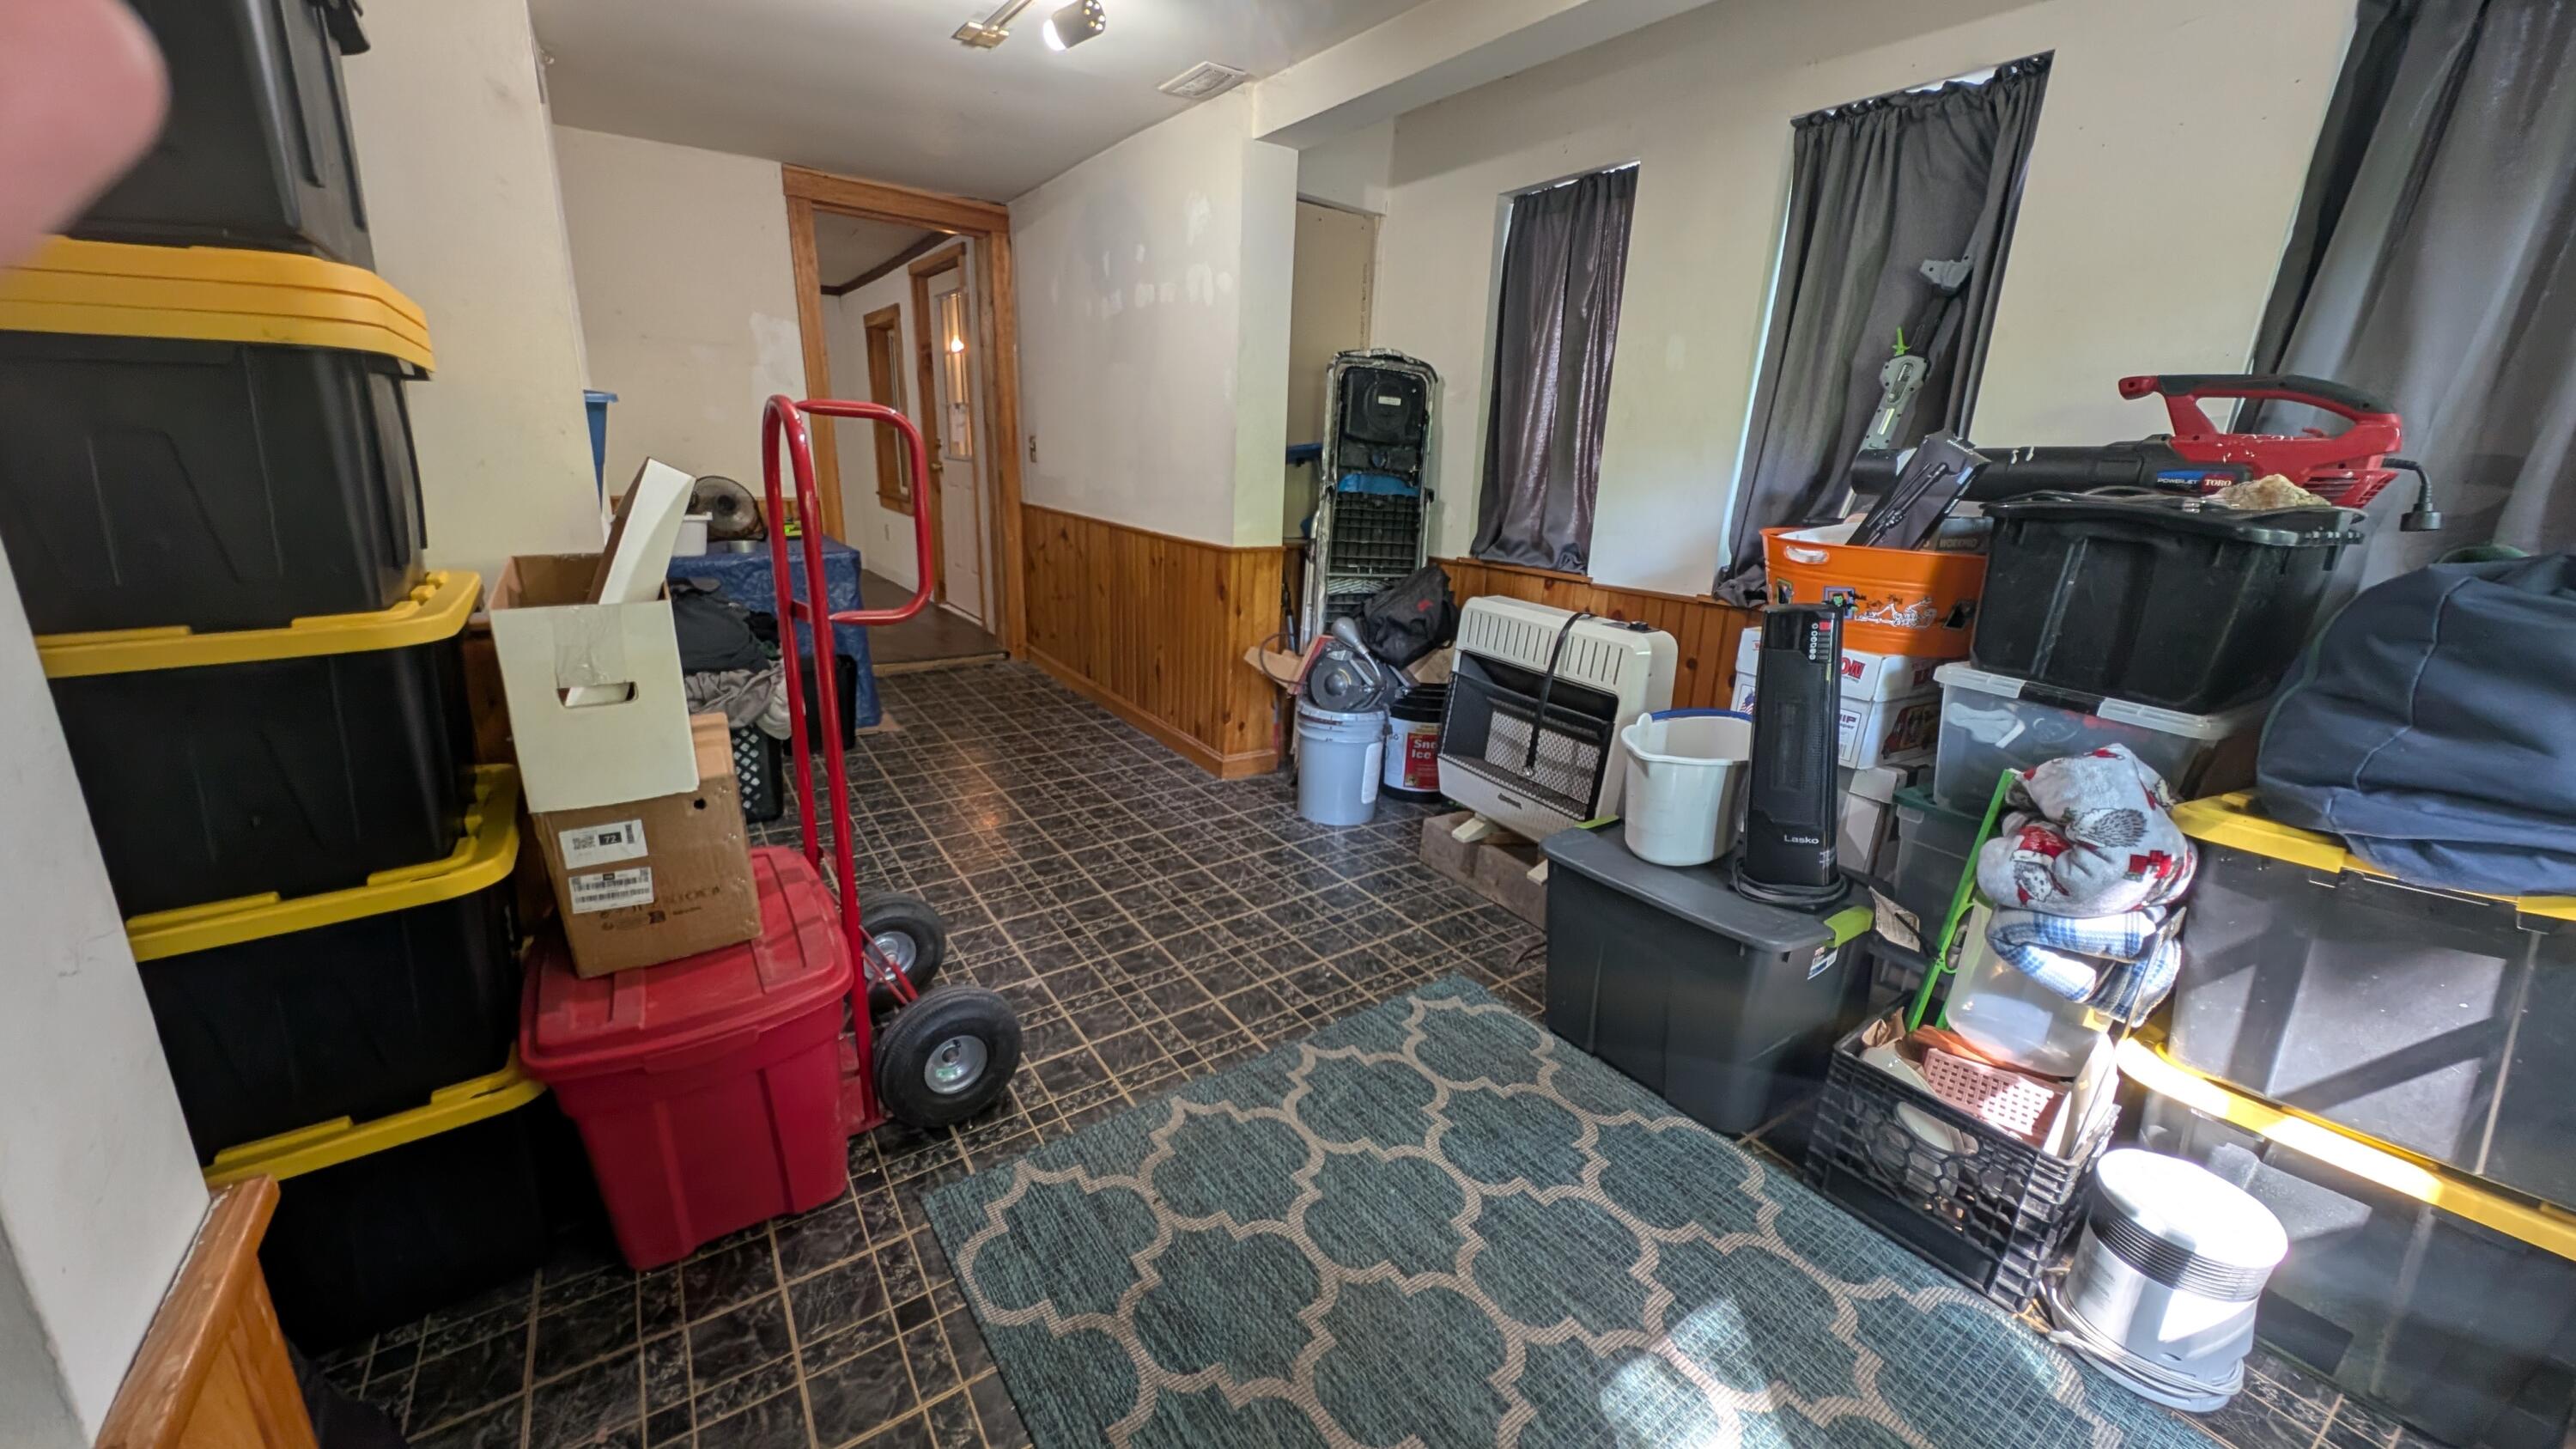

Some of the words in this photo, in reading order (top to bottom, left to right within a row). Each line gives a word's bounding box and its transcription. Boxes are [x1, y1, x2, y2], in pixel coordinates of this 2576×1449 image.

[1413, 739, 1438, 749] Sno
[1412, 748, 1432, 759] Ice
[605, 834, 617, 843] 72
[1783, 833, 1820, 844] Lasko
